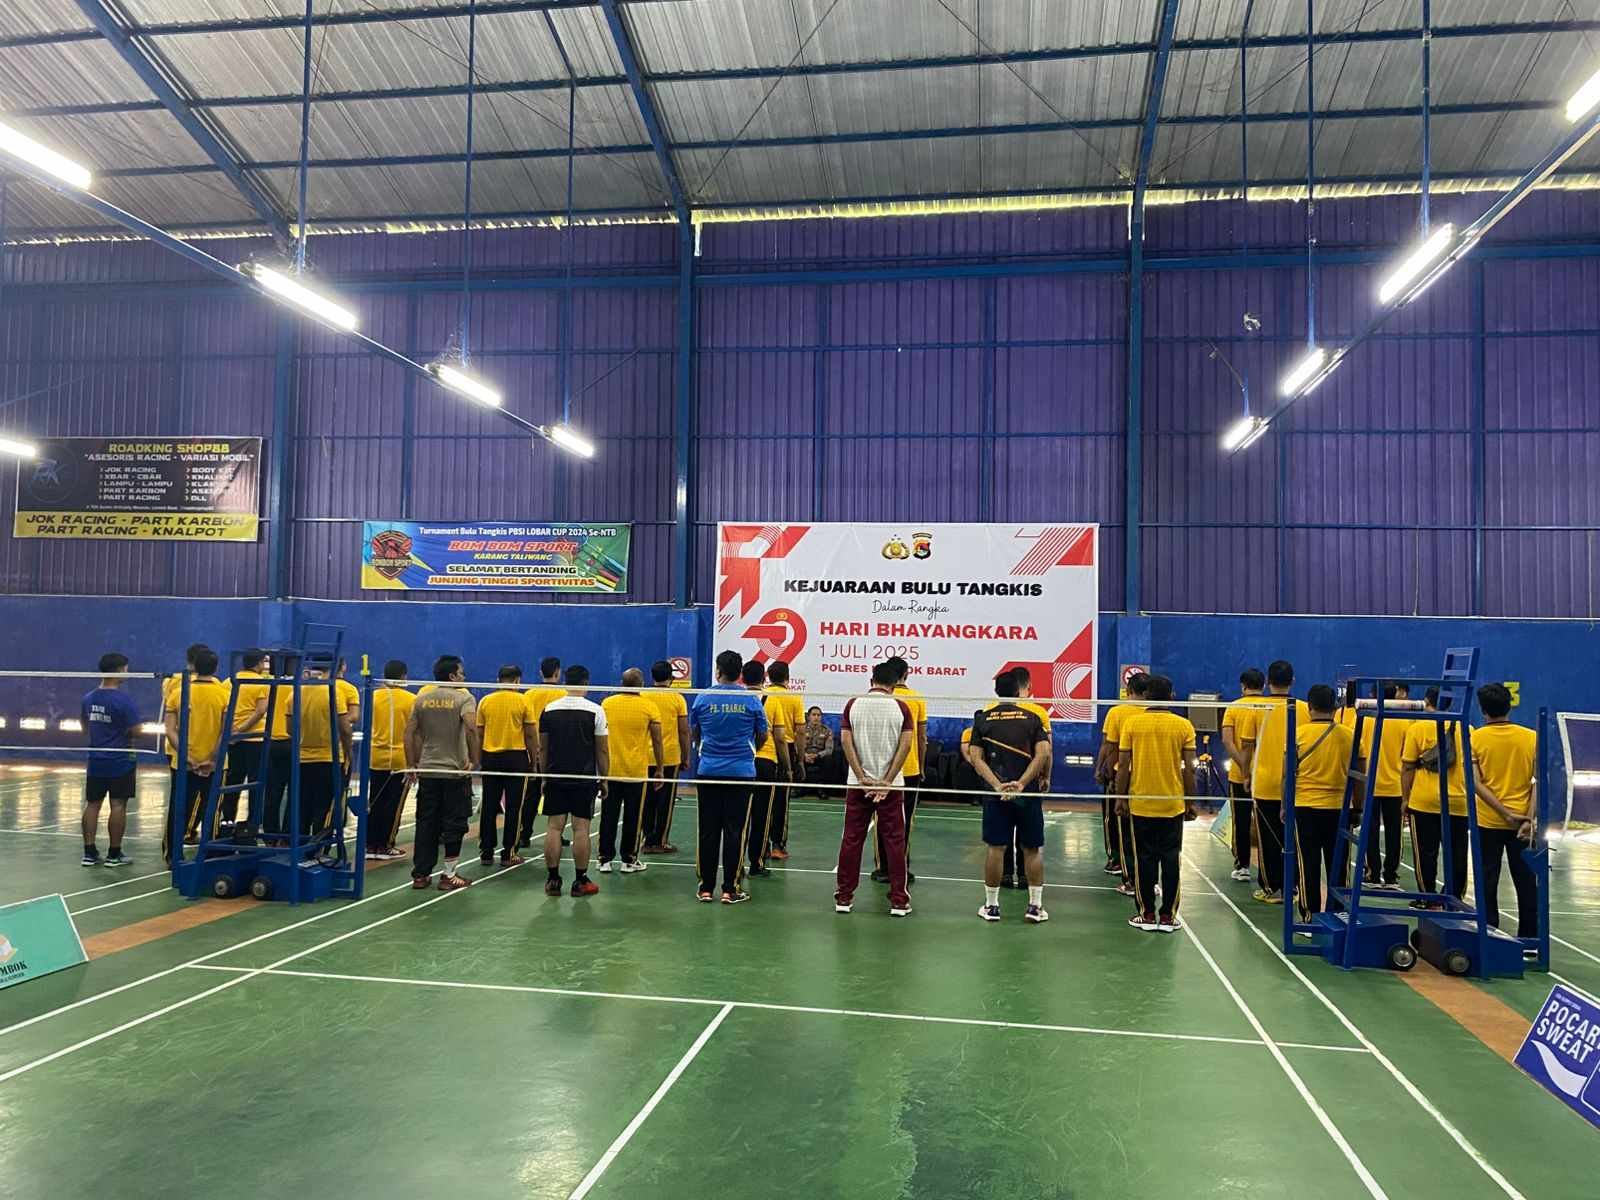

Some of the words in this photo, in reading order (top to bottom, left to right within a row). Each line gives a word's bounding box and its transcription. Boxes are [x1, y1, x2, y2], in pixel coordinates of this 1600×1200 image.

[108, 443, 173, 453] ROADKING
[136, 453, 171, 461] RACING
[180, 453, 219, 461] VARIASI
[128, 487, 167, 495] KARBON
[26, 514, 55, 524] JOK
[61, 515, 117, 525] RACING
[131, 516, 173, 526] PART
[177, 517, 245, 527] KARBON
[36, 525, 77, 534] PART
[81, 526, 138, 536] RACING
[151, 527, 227, 537] KNALPOT
[478, 528, 507, 536] Tangkis
[508, 528, 525, 536] PBSI
[526, 528, 551, 536] LOBAR
[552, 528, 567, 536] CUP
[568, 528, 587, 536] 2024
[588, 528, 617, 536] Se-NTB
[448, 540, 485, 551] BOM
[485, 541, 523, 551] BOM
[523, 541, 578, 552] SPORT
[447, 564, 501, 574] SELAMAT
[503, 565, 577, 575] BERTANDING
[429, 576, 479, 585] JUNJUNG
[480, 576, 518, 586] TINGGI
[520, 577, 595, 587] SPORTIVITAS
[784, 579, 896, 594] KEJUARAAN
[901, 581, 951, 595] BULU
[957, 582, 1043, 597] TANGKIS
[871, 599, 906, 614] Dalam
[907, 599, 950, 621] Rangka
[820, 622, 869, 636] HARI
[877, 623, 1038, 641] BHAYANGKARA
[818, 644, 826, 658] 1
[829, 644, 867, 658] JULI
[872, 645, 920, 661] 2025
[821, 663, 868, 673] POLRES
[926, 666, 968, 676] BARAT
[421, 699, 455, 709] POLISI
[0, 960, 28, 976] MBOK
[1545, 999, 1600, 1049] POCAR
[1536, 1017, 1594, 1064] SWEAT
